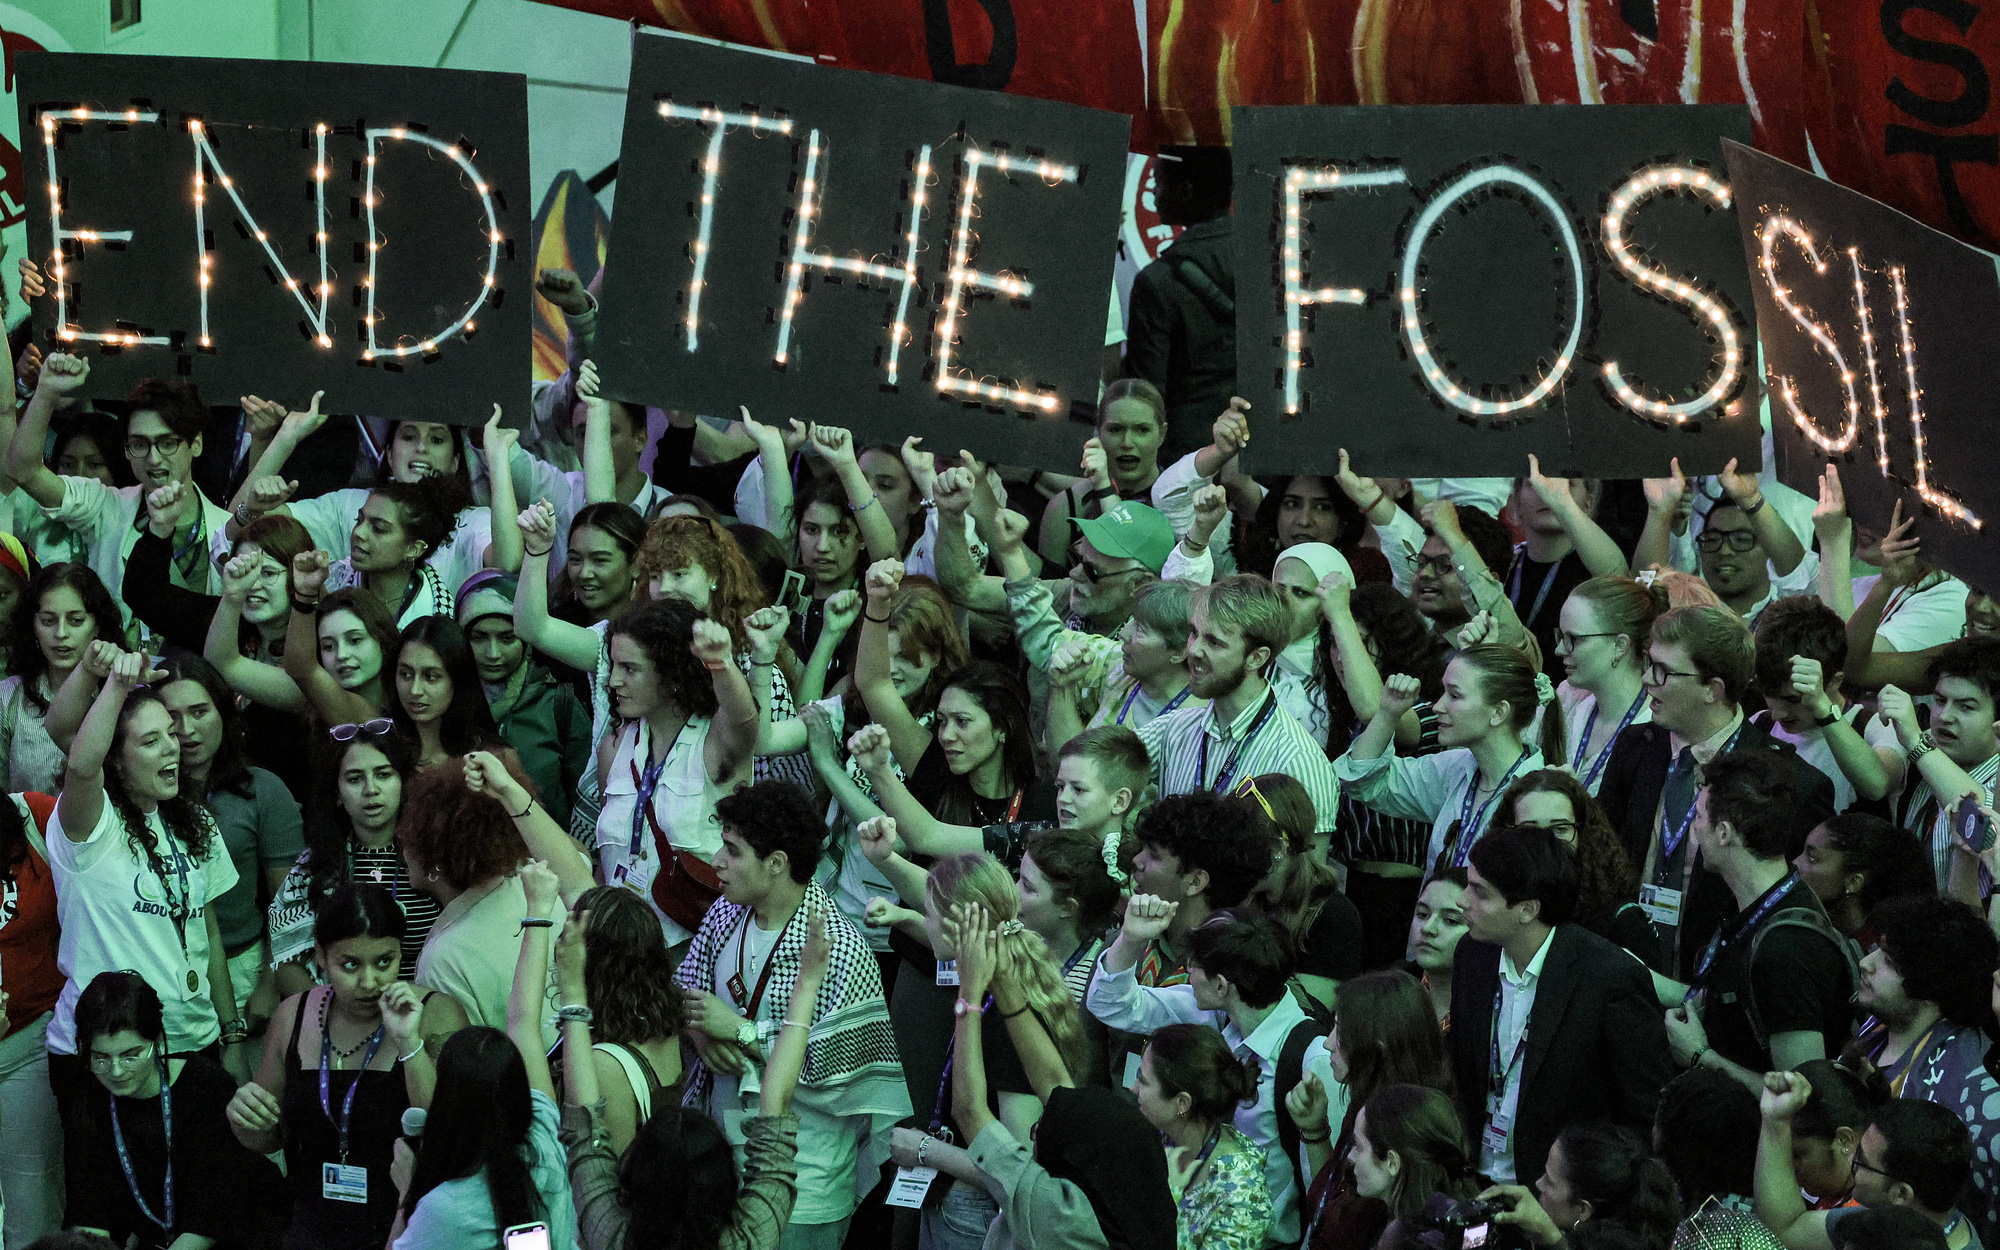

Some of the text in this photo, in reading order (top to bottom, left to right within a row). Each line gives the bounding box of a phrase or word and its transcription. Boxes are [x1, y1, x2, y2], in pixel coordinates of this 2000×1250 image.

[42, 107, 500, 361] END
[658, 102, 1078, 410] THE
[132, 900, 178, 919] ABOU
